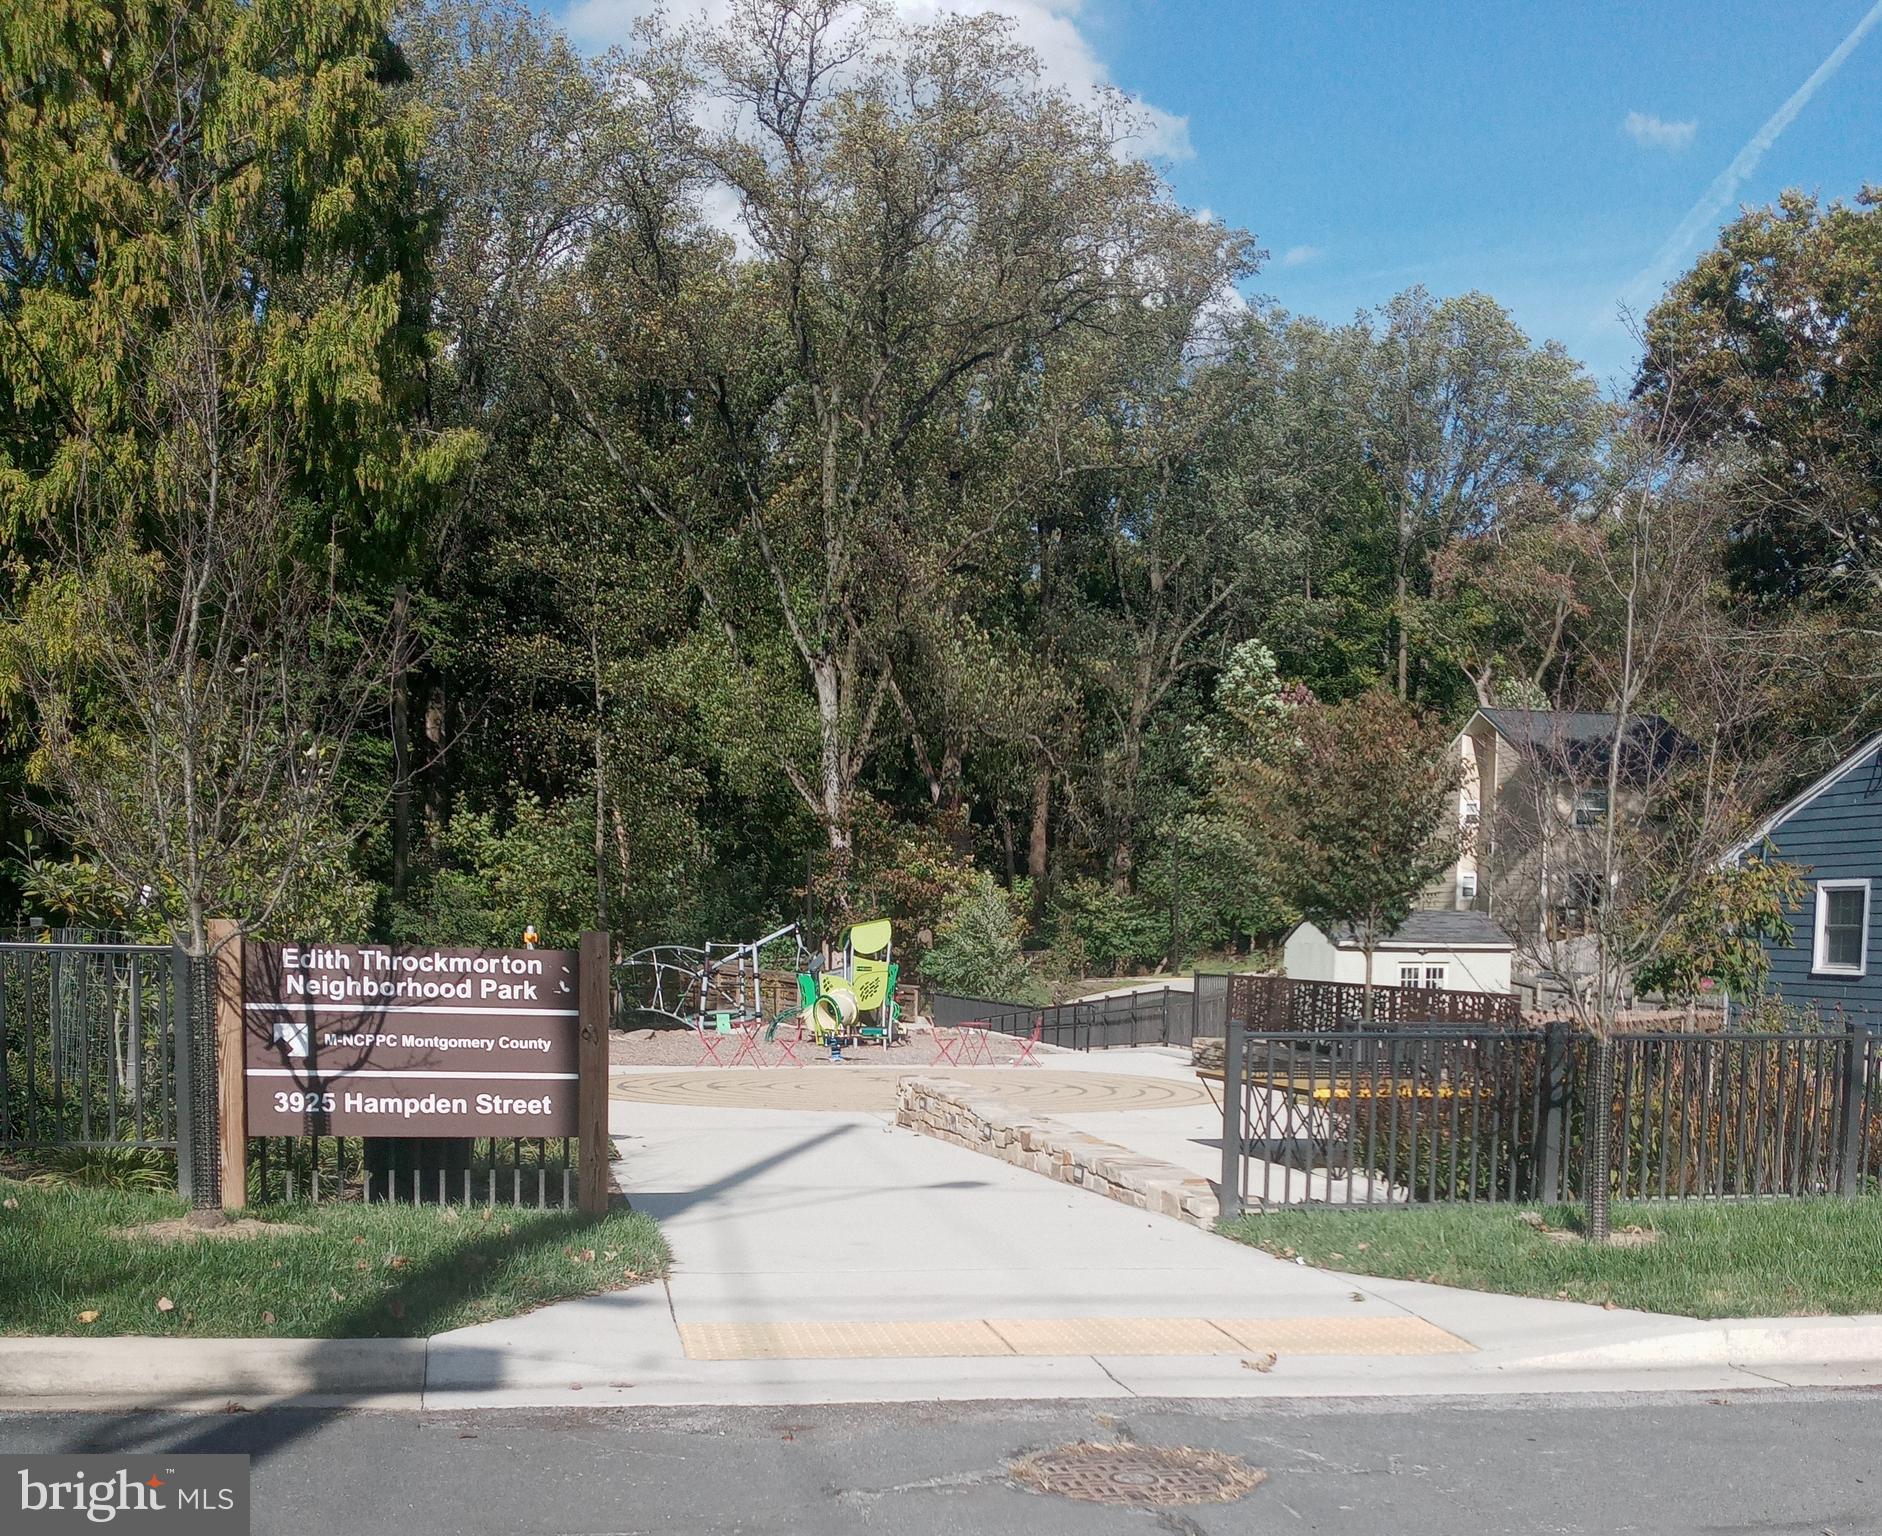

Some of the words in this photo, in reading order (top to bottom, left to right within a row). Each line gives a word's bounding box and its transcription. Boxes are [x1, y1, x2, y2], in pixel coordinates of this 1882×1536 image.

[282, 948, 350, 970] Edith
[358, 950, 542, 975] Throckmorton
[286, 974, 472, 1001] Neighborhood
[480, 979, 538, 1000] Park
[324, 1033, 398, 1047] M-NCPPC
[401, 1034, 495, 1051] Montgomery
[498, 1036, 552, 1053] County
[273, 1091, 336, 1113] 3925
[344, 1092, 468, 1118] Hampden
[475, 1094, 552, 1115] Street
